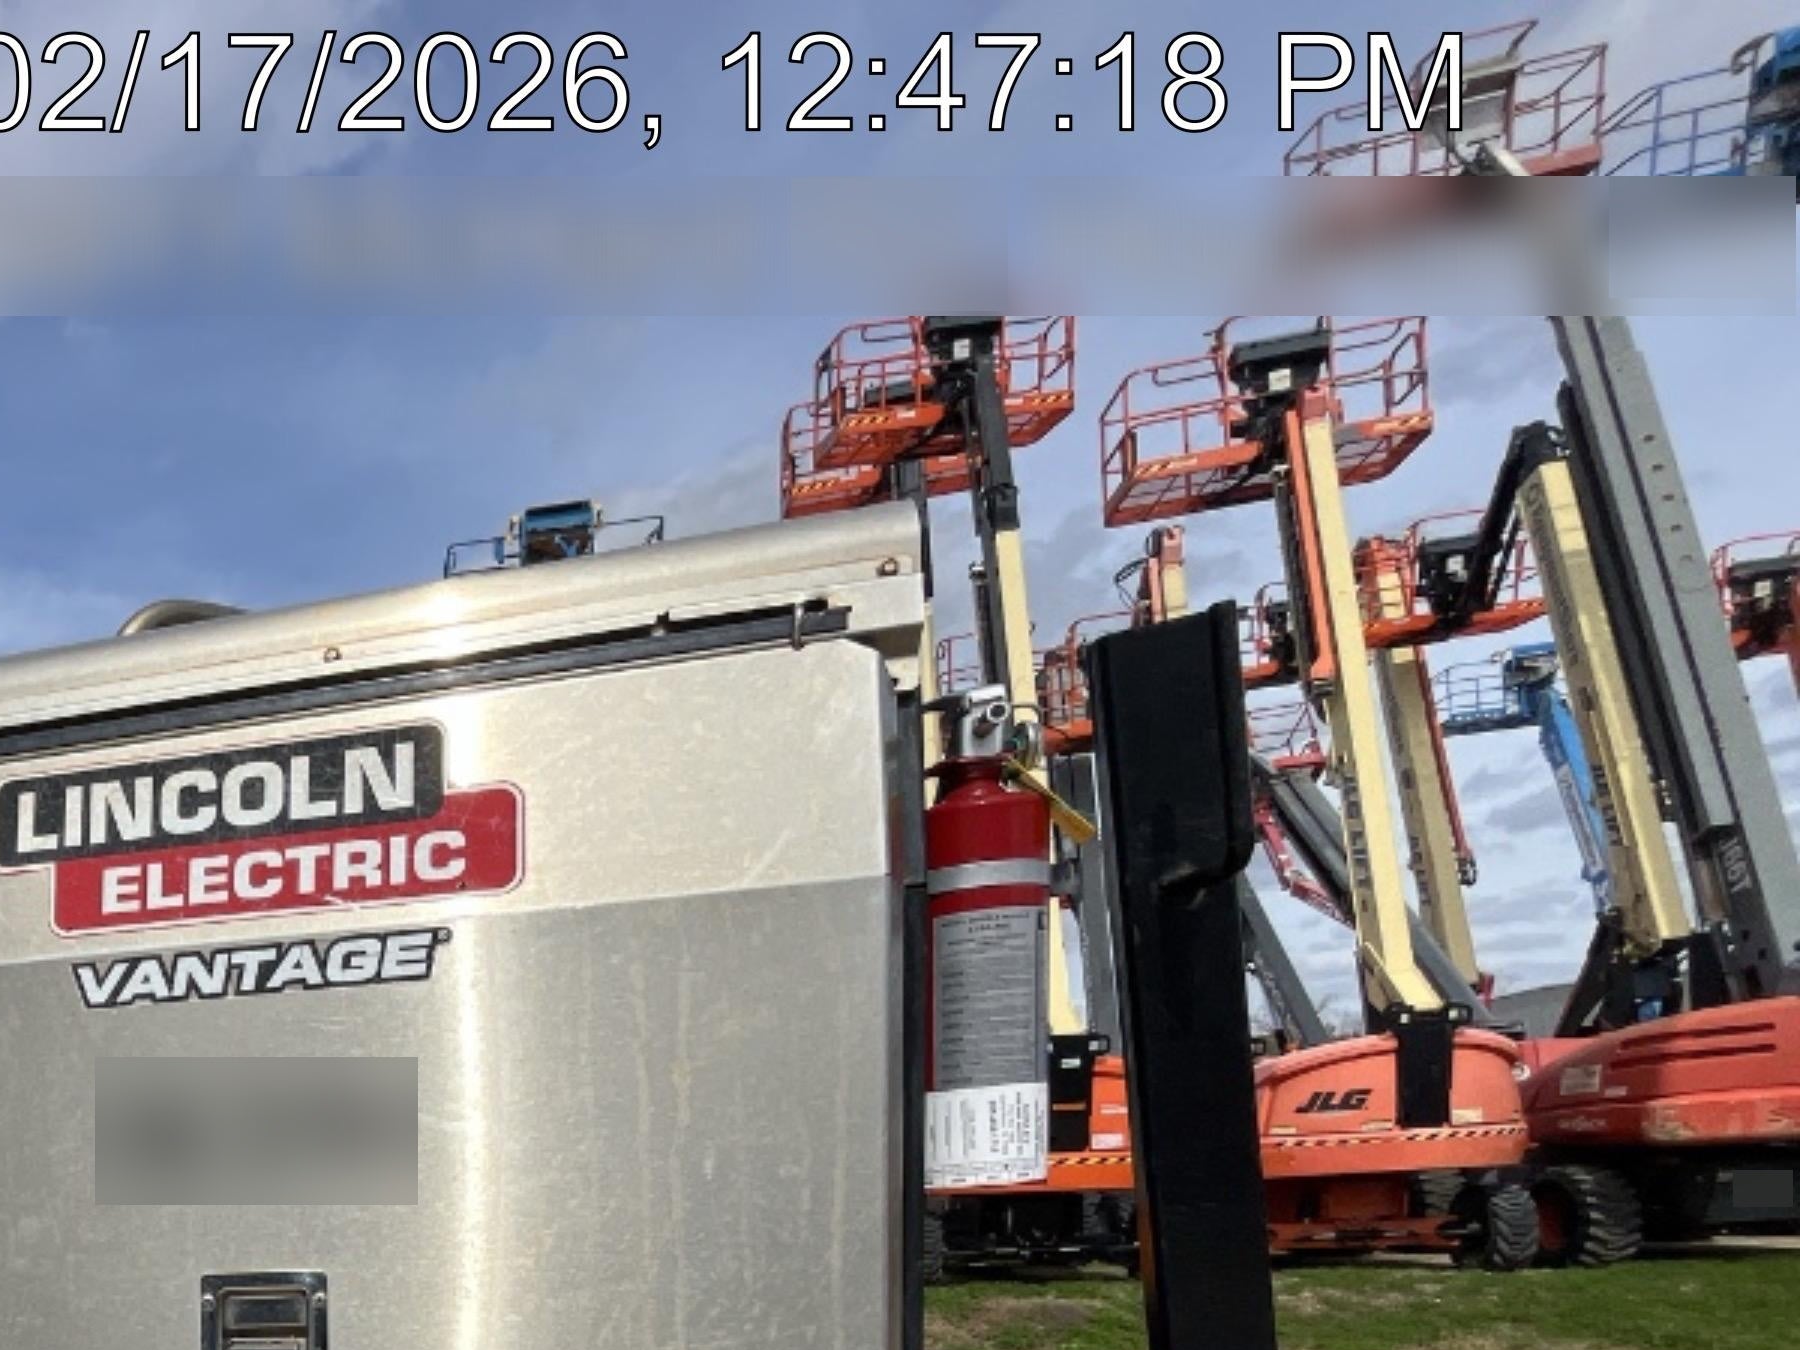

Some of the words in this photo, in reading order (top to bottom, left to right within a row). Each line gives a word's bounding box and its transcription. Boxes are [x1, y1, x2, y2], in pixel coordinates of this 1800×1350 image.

[16, 741, 416, 853] LINCOLN
[100, 830, 467, 915] ELECTRIC
[1294, 1088, 1373, 1113] JLG
